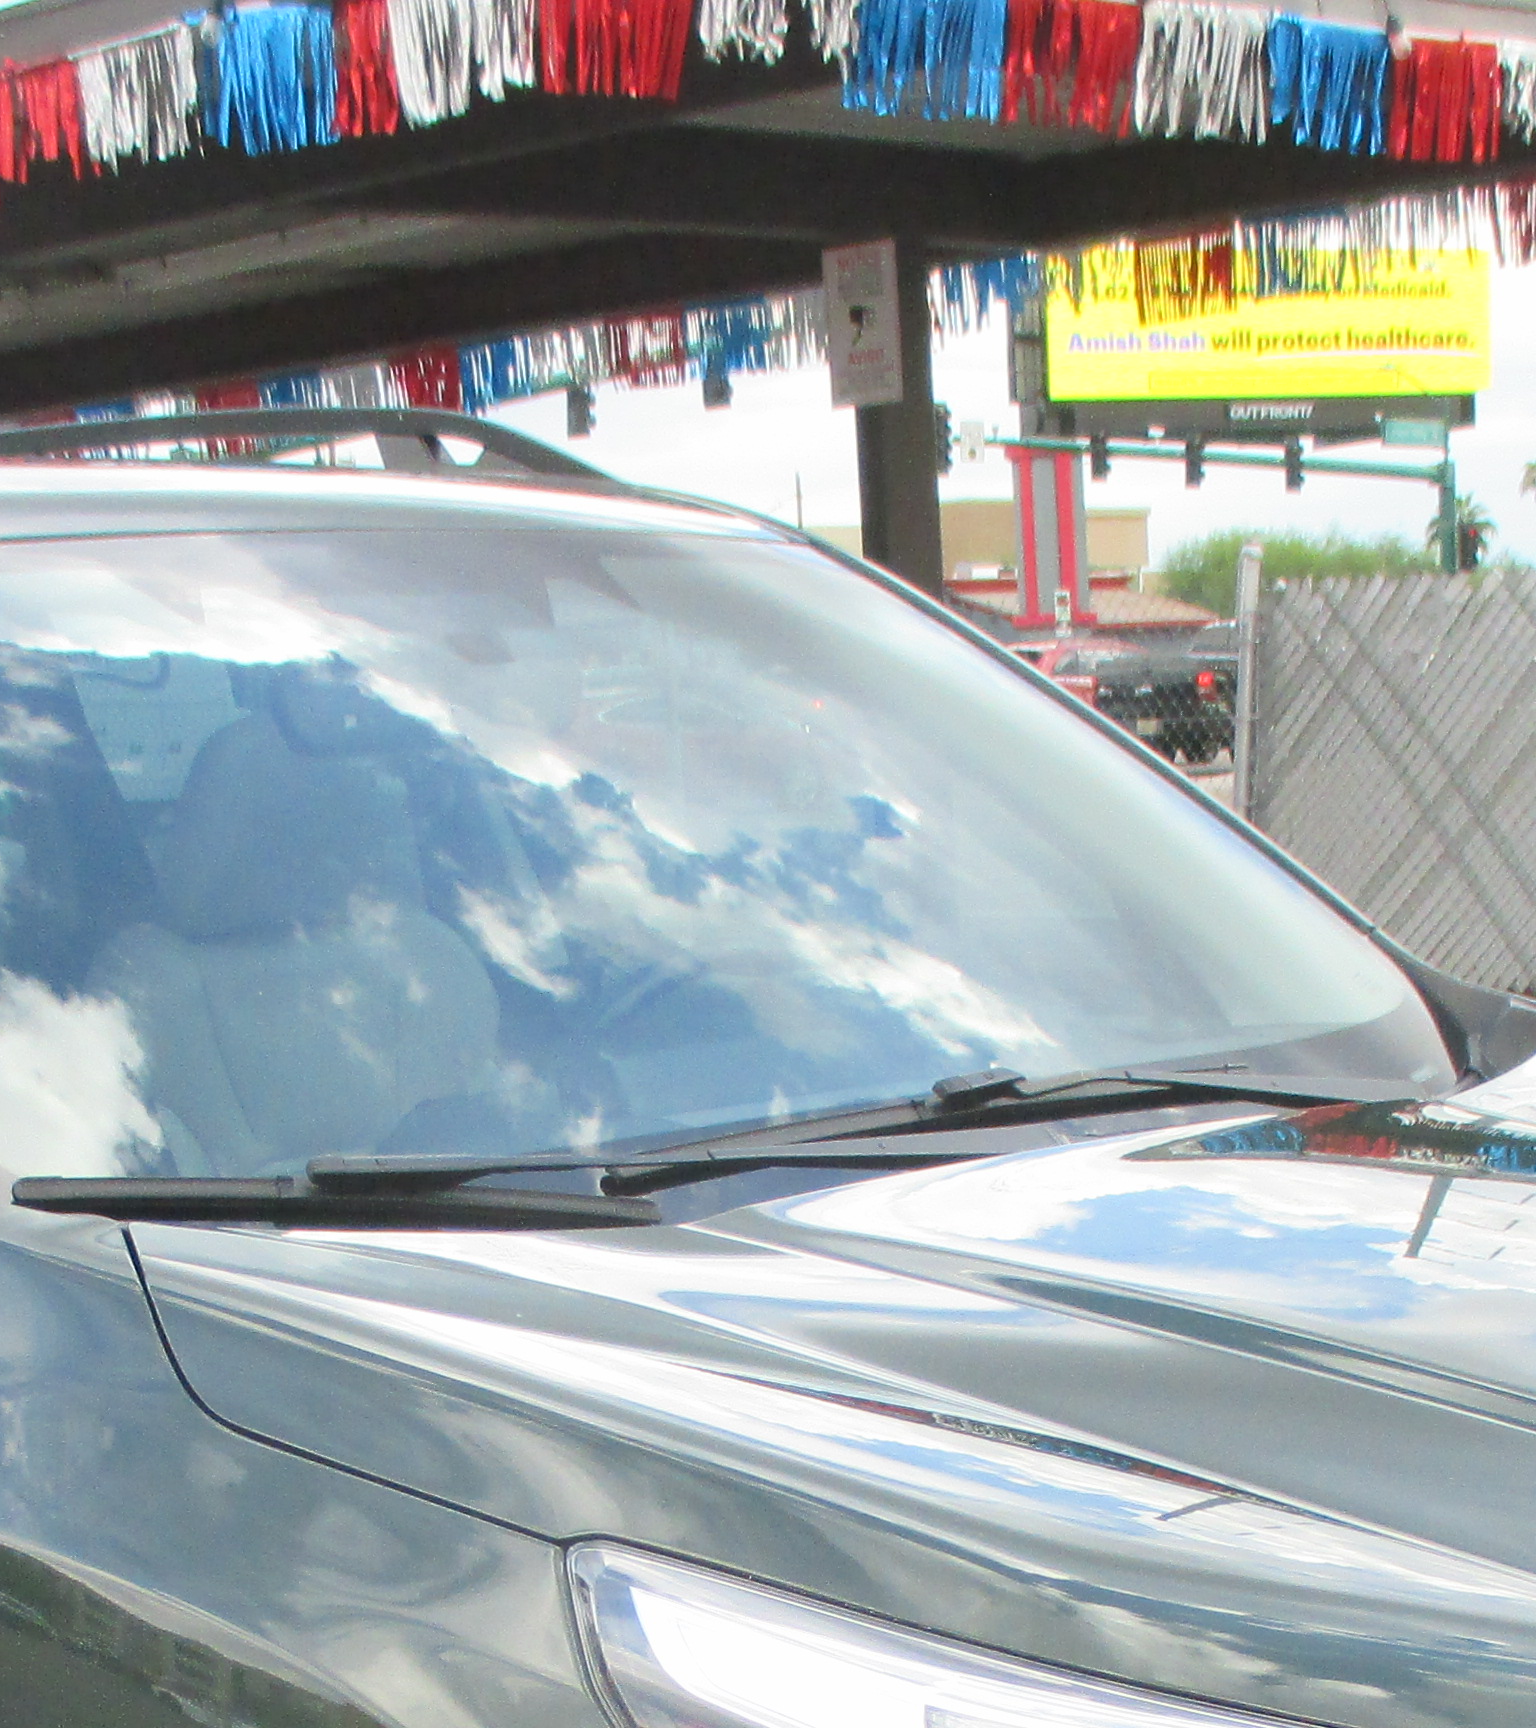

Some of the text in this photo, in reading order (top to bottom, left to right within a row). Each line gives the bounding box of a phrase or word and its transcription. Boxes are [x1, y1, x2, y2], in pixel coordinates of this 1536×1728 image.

[1069, 327, 1476, 356] Amish Shah will protect healthcare.
